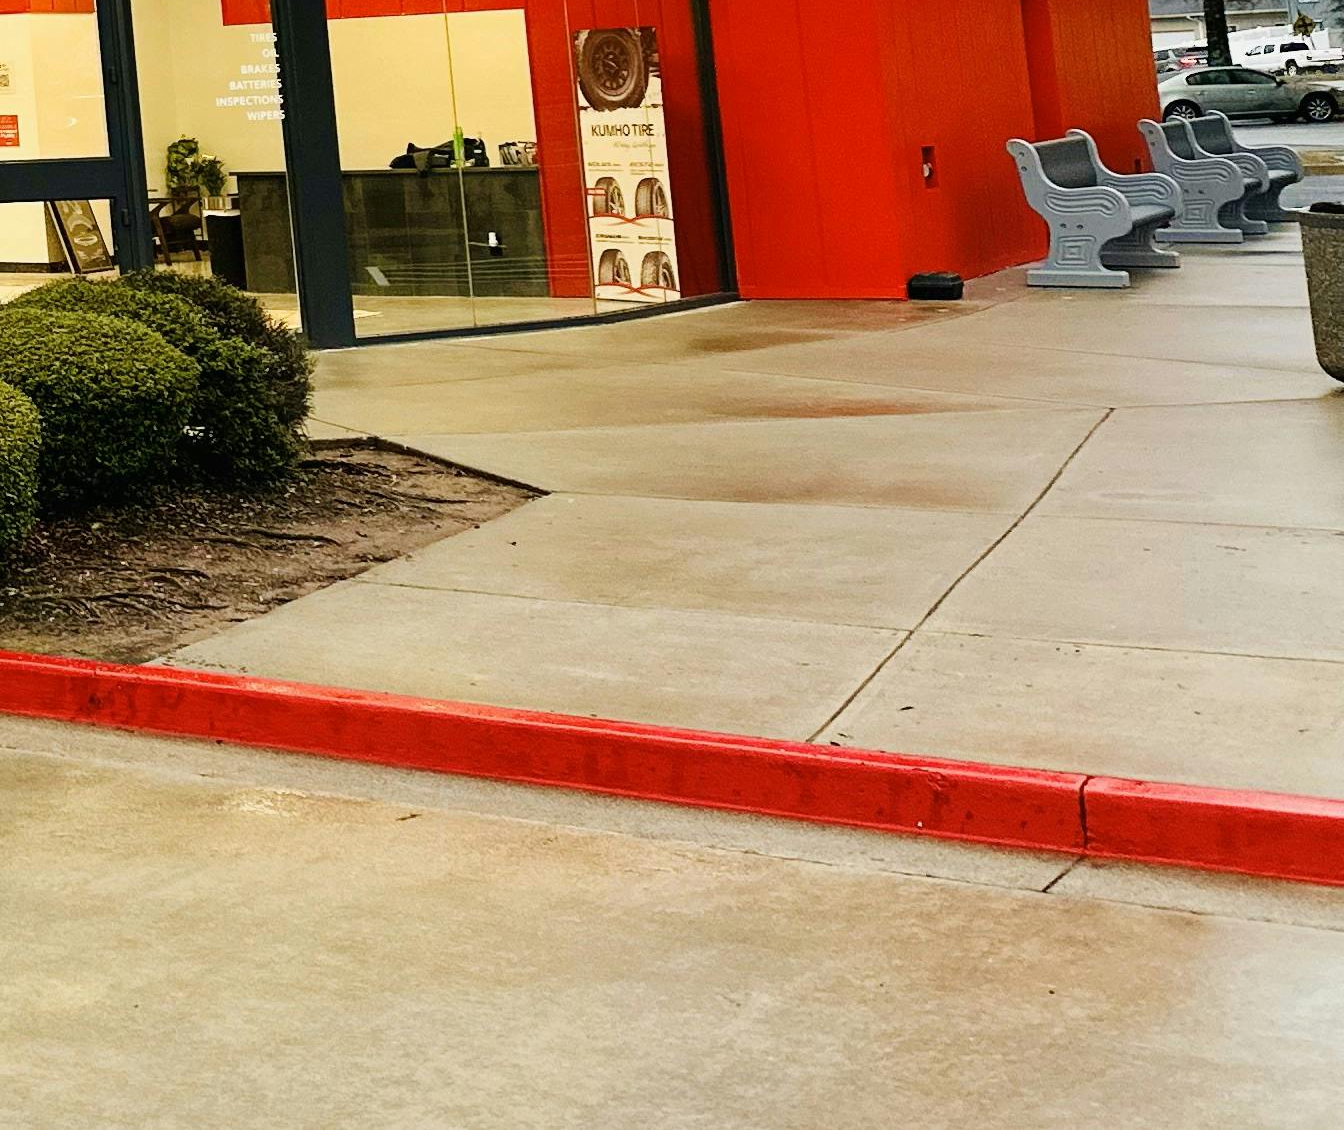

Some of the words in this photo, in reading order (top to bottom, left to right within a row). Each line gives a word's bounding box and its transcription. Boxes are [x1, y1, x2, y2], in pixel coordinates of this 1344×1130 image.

[249, 32, 278, 43] TIRES
[262, 48, 280, 58] OIL
[240, 64, 281, 74] BRAKES
[229, 79, 283, 91] BATTERIES
[216, 95, 284, 107] INSPECTIONS
[246, 110, 286, 121] WIPERS
[591, 124, 630, 137] KUMHO
[631, 123, 654, 136] TIRE
